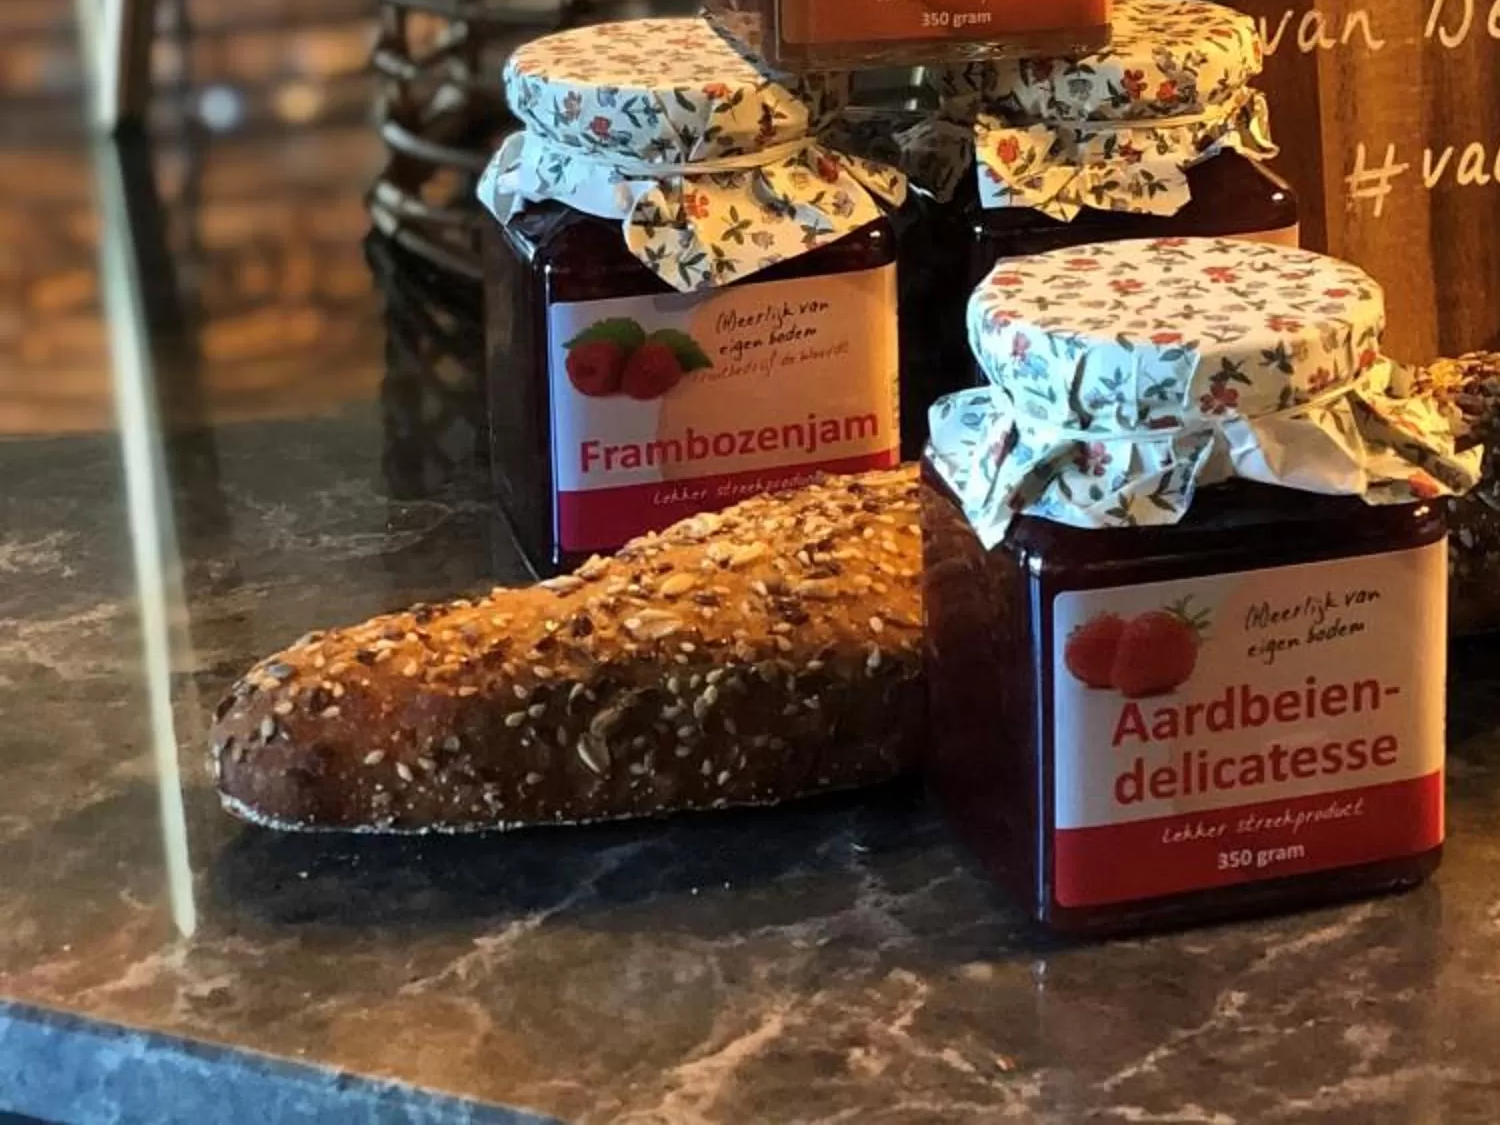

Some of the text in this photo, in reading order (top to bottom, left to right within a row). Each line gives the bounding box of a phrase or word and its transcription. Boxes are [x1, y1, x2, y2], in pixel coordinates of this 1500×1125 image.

[920, 11, 993, 29] 350 gram
[1256, 6, 1387, 58] van
[798, 299, 830, 314] van
[718, 322, 818, 361] eigen bodem
[579, 410, 880, 475] Frambozenjam
[1344, 588, 1382, 609] van
[1246, 617, 1366, 667] eigen bodem
[1111, 676, 1401, 748] Aardbeien-
[1113, 734, 1399, 806] delicatesse
[1216, 843, 1306, 871] 350 gram
